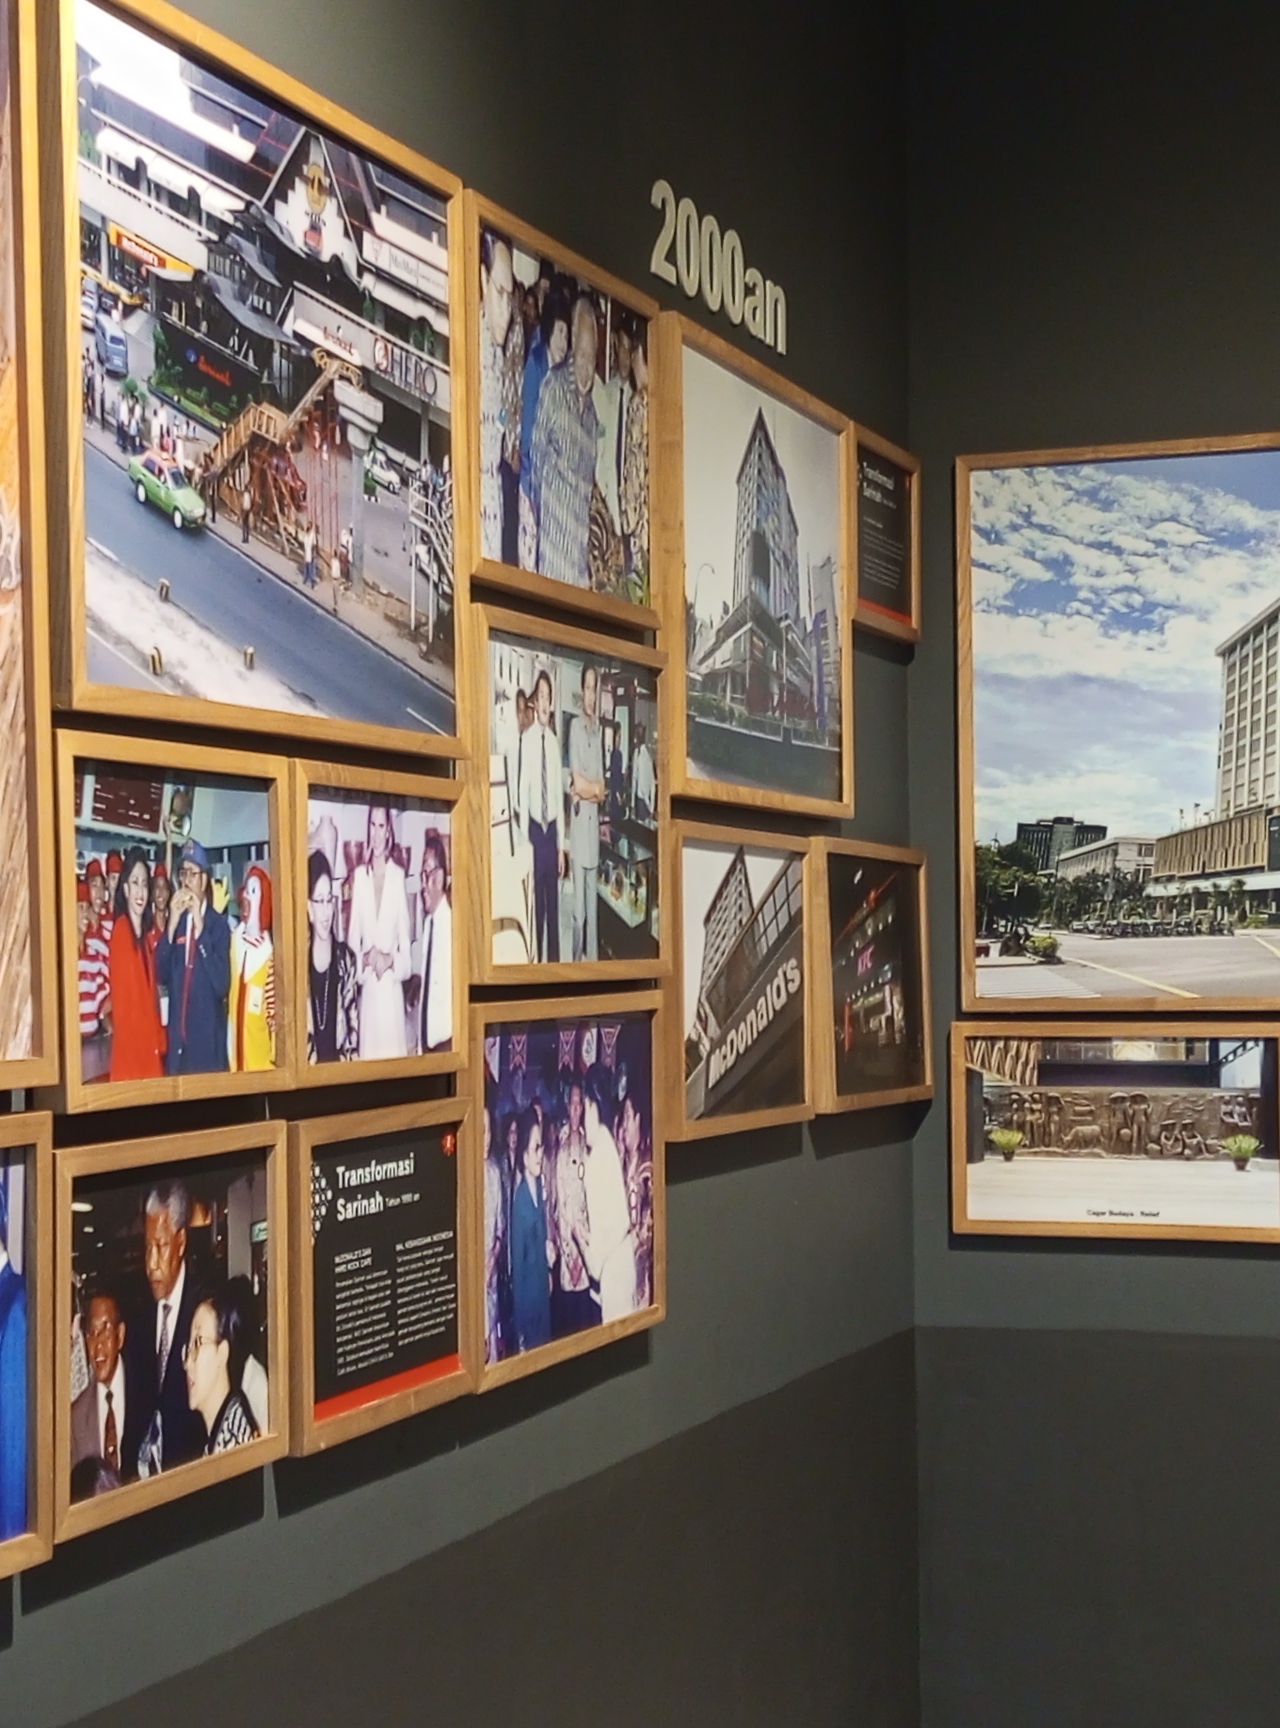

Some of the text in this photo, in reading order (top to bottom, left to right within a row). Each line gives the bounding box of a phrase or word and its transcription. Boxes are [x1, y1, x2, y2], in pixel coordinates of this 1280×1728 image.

[650, 179, 787, 356] 2000an
[708, 957, 802, 1090] McDonald's
[336, 1152, 414, 1189] Transformasi
[337, 1190, 384, 1221] Sarinah
